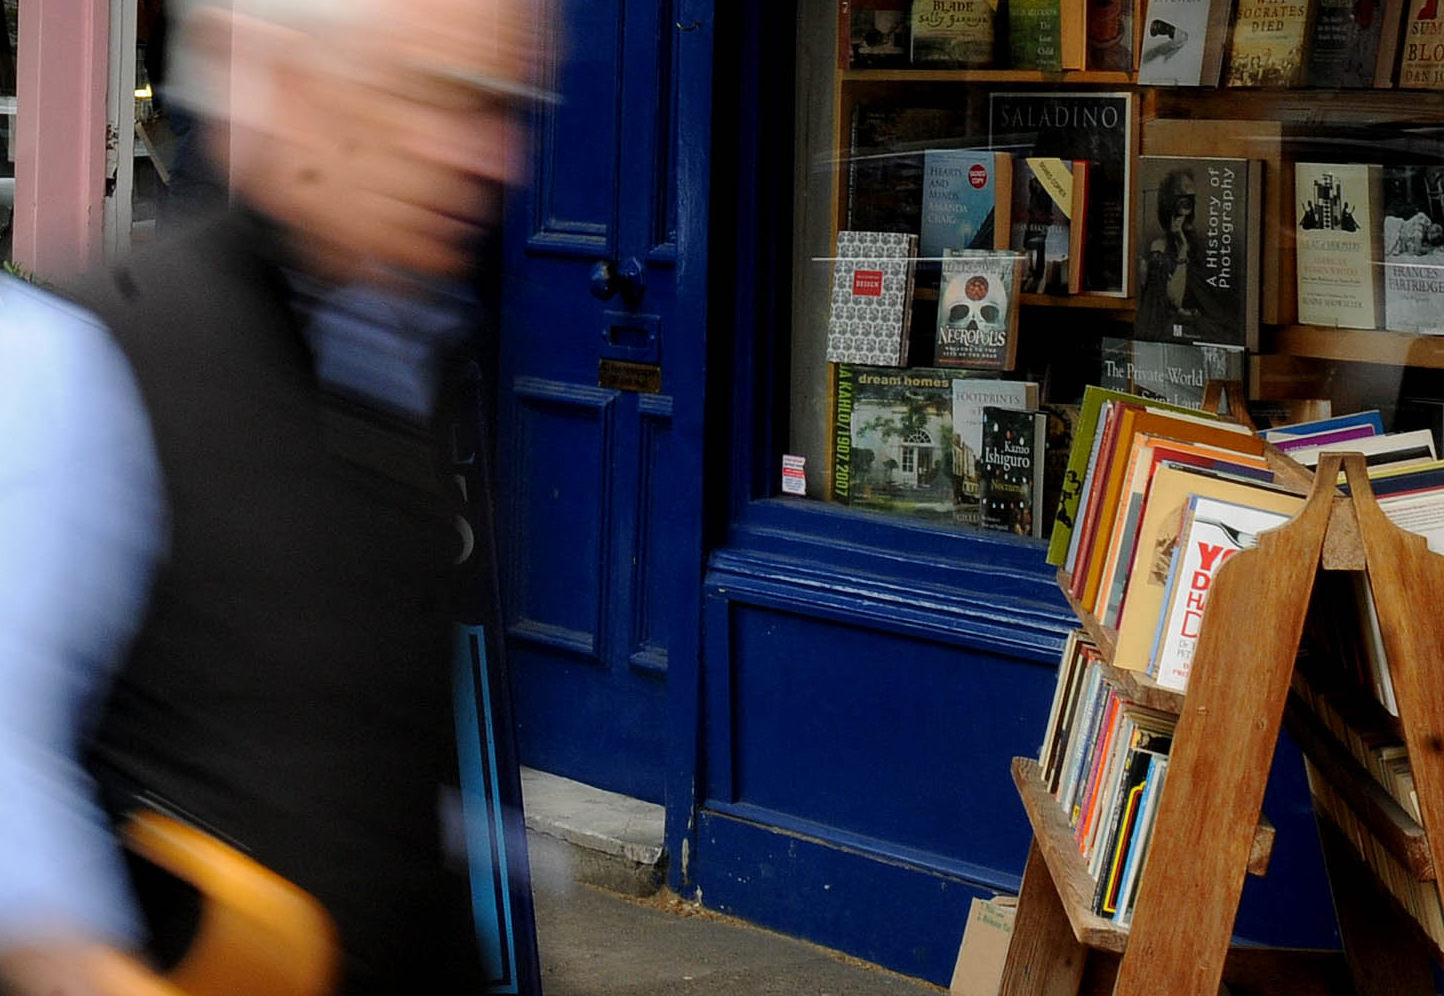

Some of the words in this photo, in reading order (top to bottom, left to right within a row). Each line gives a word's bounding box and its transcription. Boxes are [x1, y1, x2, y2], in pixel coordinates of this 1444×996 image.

[1237, 5, 1306, 21] SOCRATES
[1251, 20, 1285, 33] DIED
[1000, 105, 1119, 129] SALADINO
[1208, 167, 1220, 188] of
[1206, 196, 1221, 268] History
[1219, 166, 1236, 289] Photography
[1206, 276, 1218, 288] A
[858, 373, 902, 386] dream
[903, 375, 950, 388] homes
[1104, 361, 1125, 379] The
[1126, 362, 1164, 383] Private
[1166, 367, 1204, 387] World
[835, 380, 852, 497] KAHLO/1907.2007
[985, 447, 1031, 471] Ishiguro
